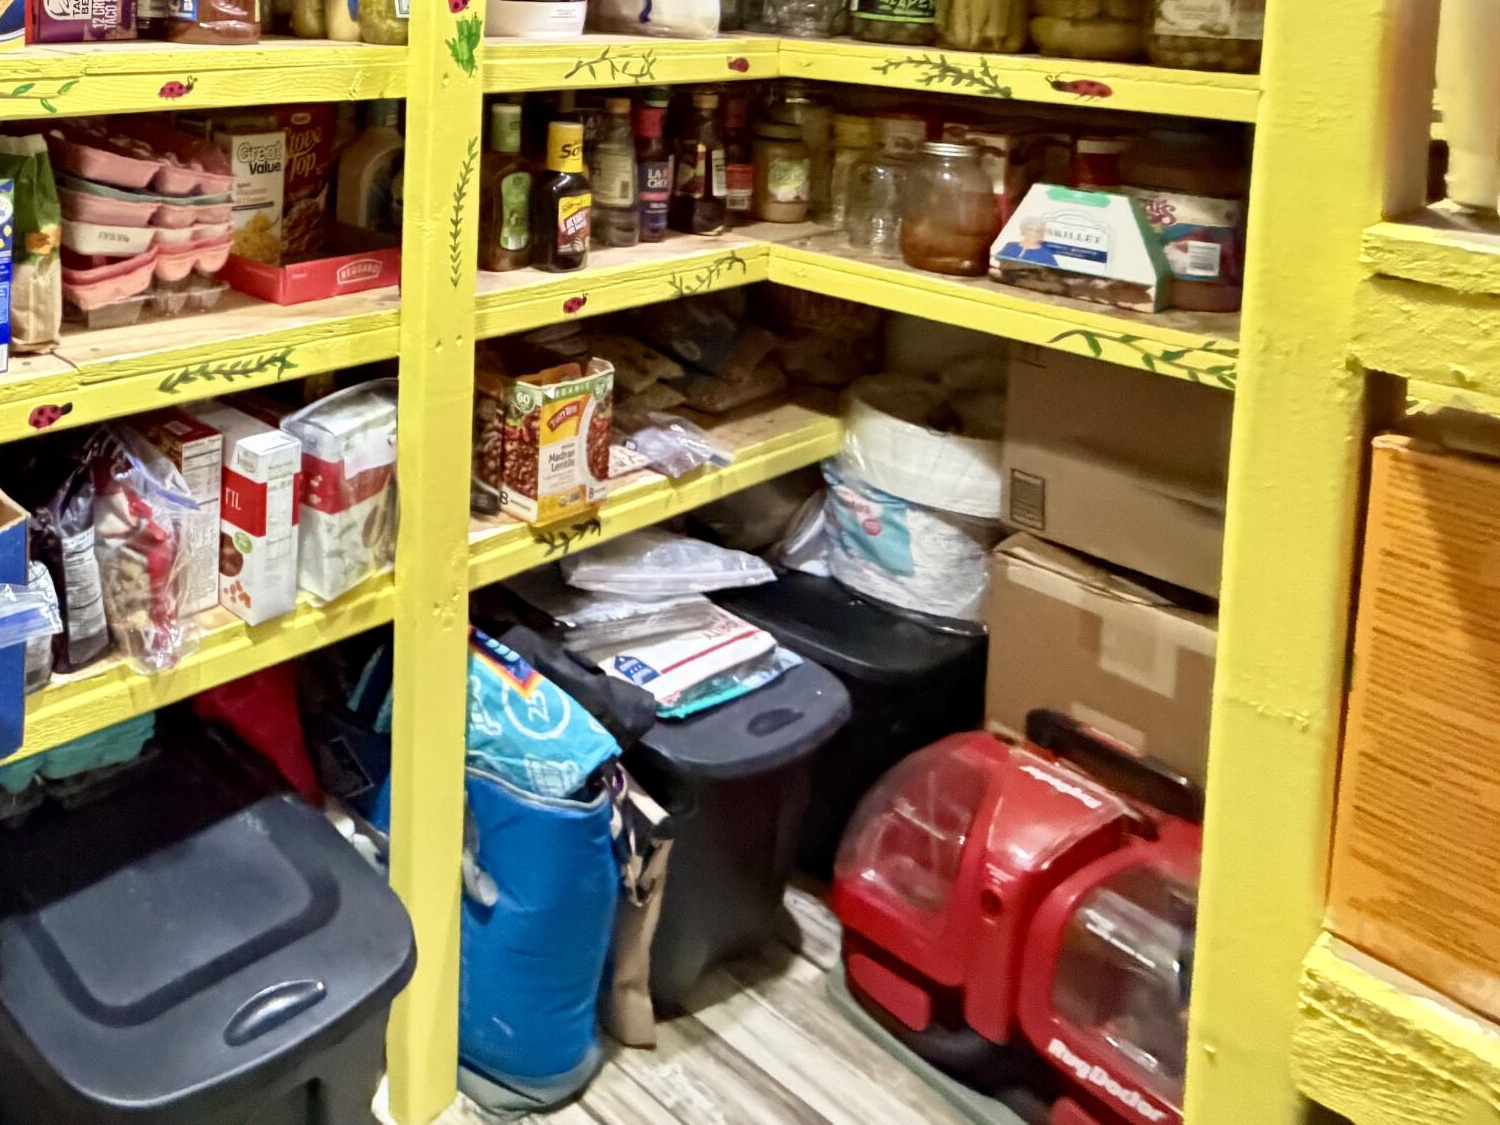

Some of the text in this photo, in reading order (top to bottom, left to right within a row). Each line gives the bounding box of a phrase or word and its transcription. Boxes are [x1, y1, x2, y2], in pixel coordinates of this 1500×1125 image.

[104, 5, 118, 30] TACO
[236, 140, 283, 165] Great
[249, 160, 282, 176] Value
[549, 449, 576, 463] Madras
[225, 487, 243, 512] TIL
